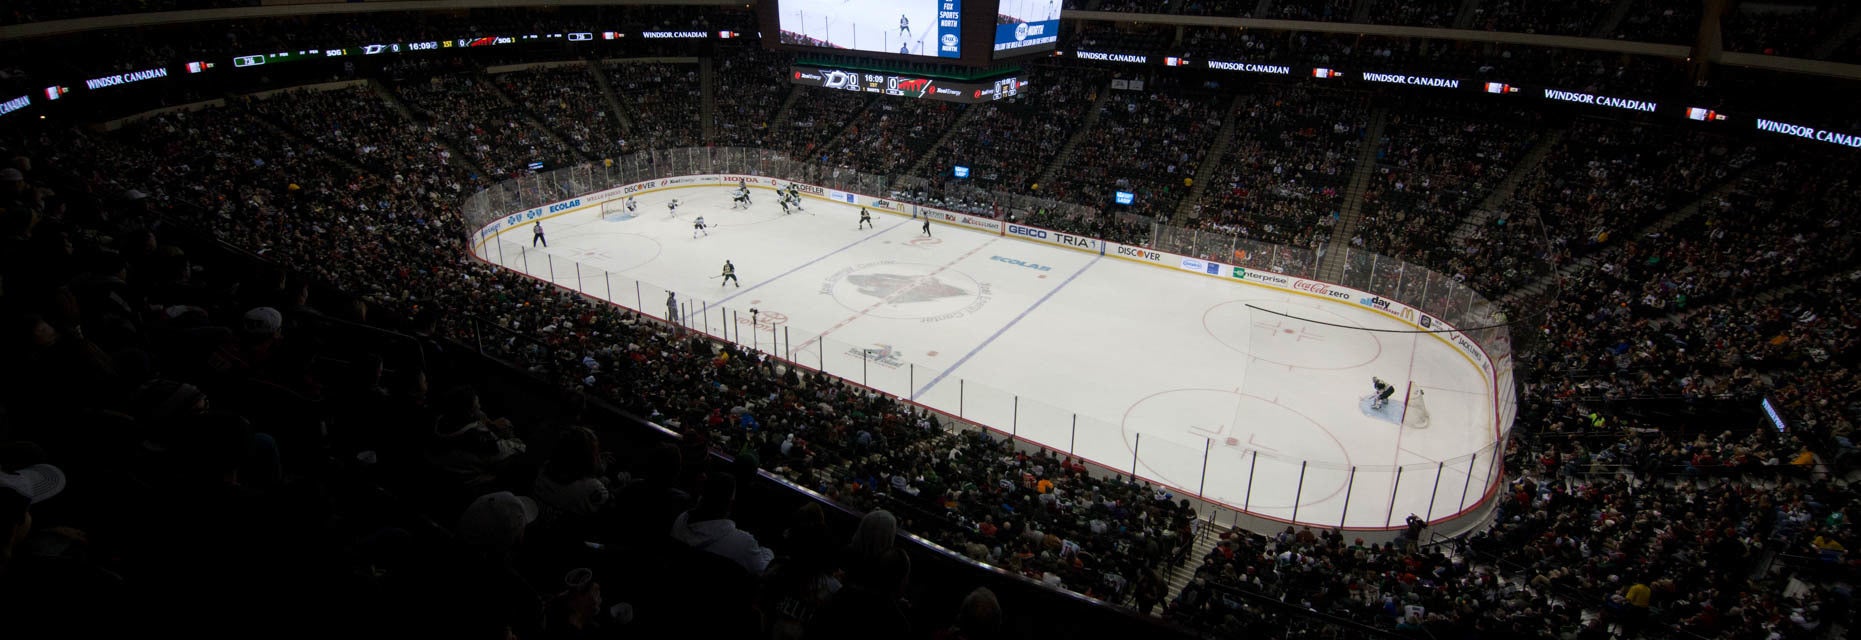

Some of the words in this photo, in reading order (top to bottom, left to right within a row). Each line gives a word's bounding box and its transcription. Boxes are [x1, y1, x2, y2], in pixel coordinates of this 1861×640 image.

[940, 11, 958, 19] SPORTS
[1027, 24, 1044, 36] NORTH
[409, 42, 430, 50] 16:09
[1077, 51, 1108, 60] WINDSOR
[1109, 54, 1146, 64] CANADIAN
[1208, 60, 1246, 72] WINDSOR
[1246, 64, 1290, 74] CANADIAN
[86, 75, 124, 90] WINDSOR
[124, 68, 167, 83] CANADIAN
[865, 75, 884, 83] 16:09
[1362, 72, 1406, 84] WINDSOR
[1408, 76, 1458, 88] CANADIAN
[1544, 88, 1594, 104] WINDSOR
[1596, 95, 1656, 112] CANADIAN
[1756, 118, 1814, 139] WINDSOR
[724, 176, 759, 184] HONDA
[624, 181, 656, 194] DISCOVER
[550, 199, 580, 213] ECOLAB
[1008, 224, 1047, 239] GEICO
[1054, 232, 1089, 248] TRIA
[1118, 246, 1161, 262] DISCOVER
[990, 255, 1052, 272] ECOLAB
[1234, 267, 1287, 284] enterprise
[1328, 288, 1350, 300] zero
[1360, 297, 1373, 306] all
[1372, 296, 1390, 309] day
